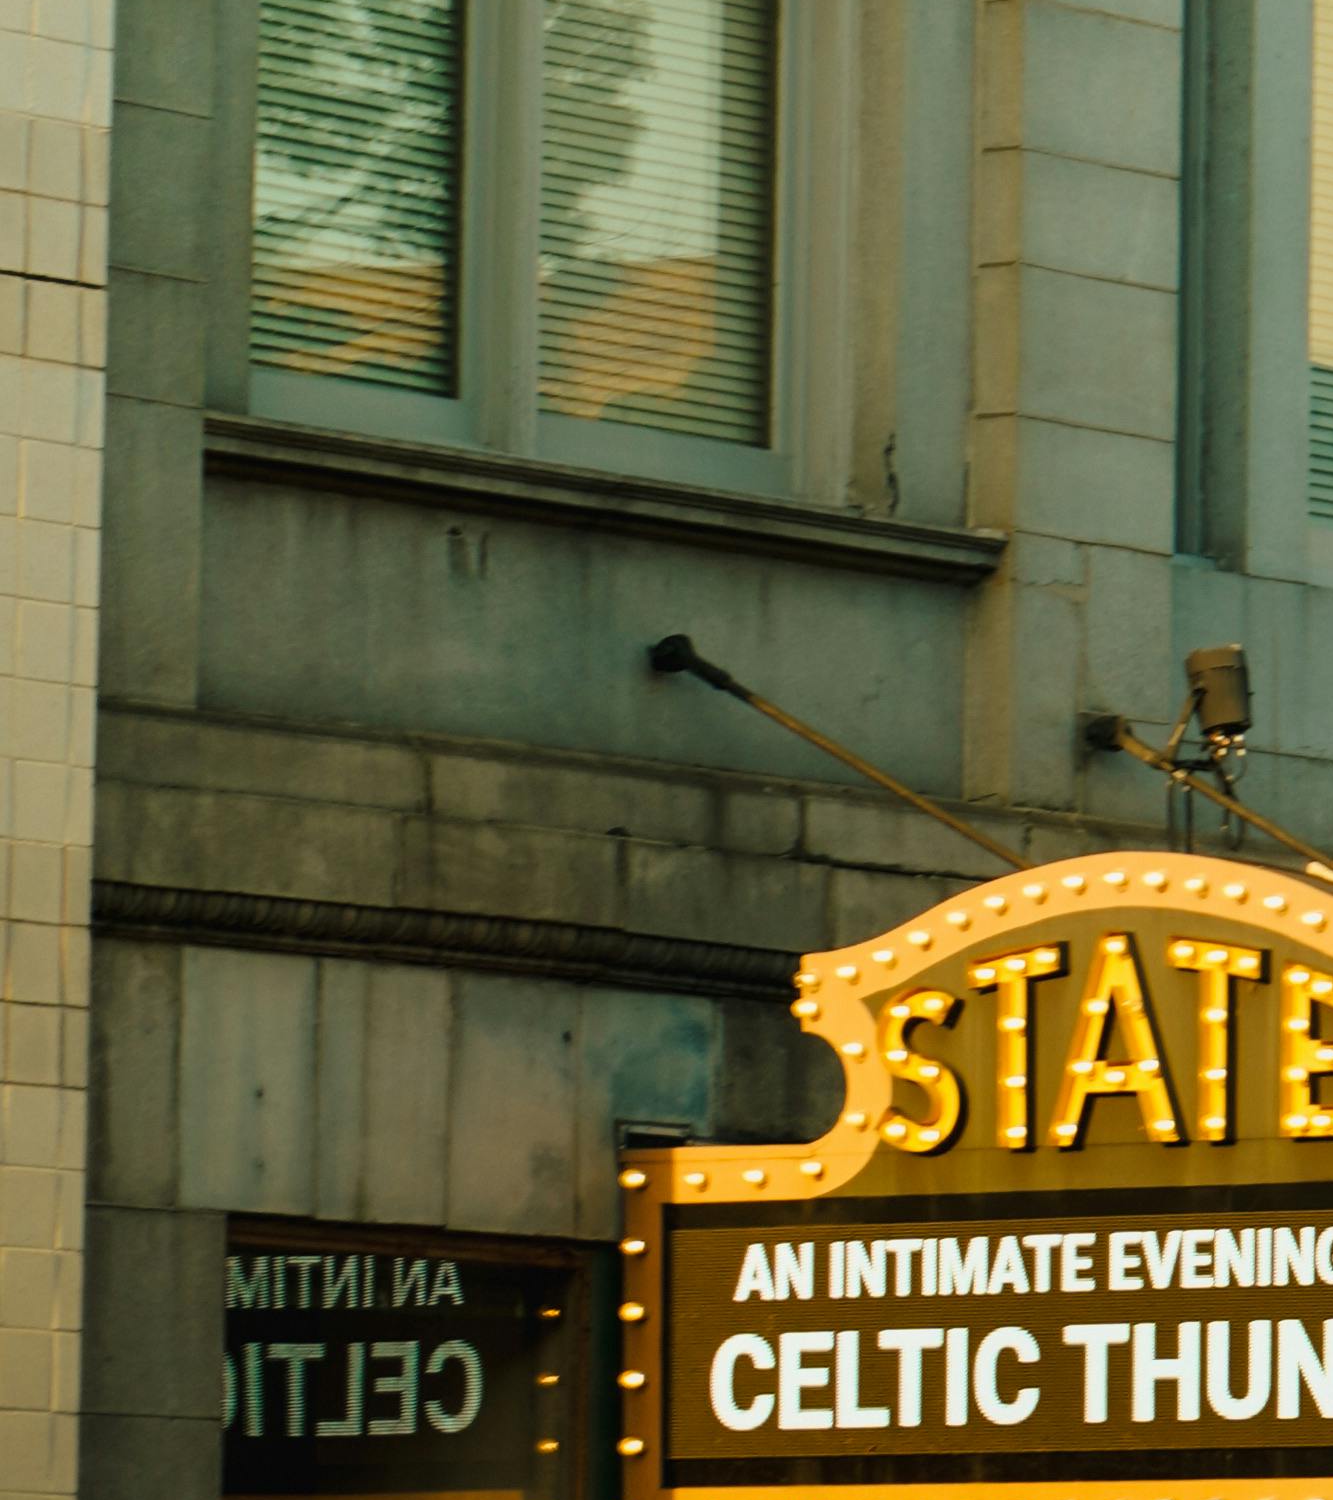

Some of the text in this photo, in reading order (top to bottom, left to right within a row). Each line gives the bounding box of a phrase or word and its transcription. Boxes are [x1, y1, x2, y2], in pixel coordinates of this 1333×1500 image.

[734, 1242, 814, 1302] AN
[830, 1232, 1096, 1298] INTIMATE
[710, 1325, 1041, 1432] CELTIC
